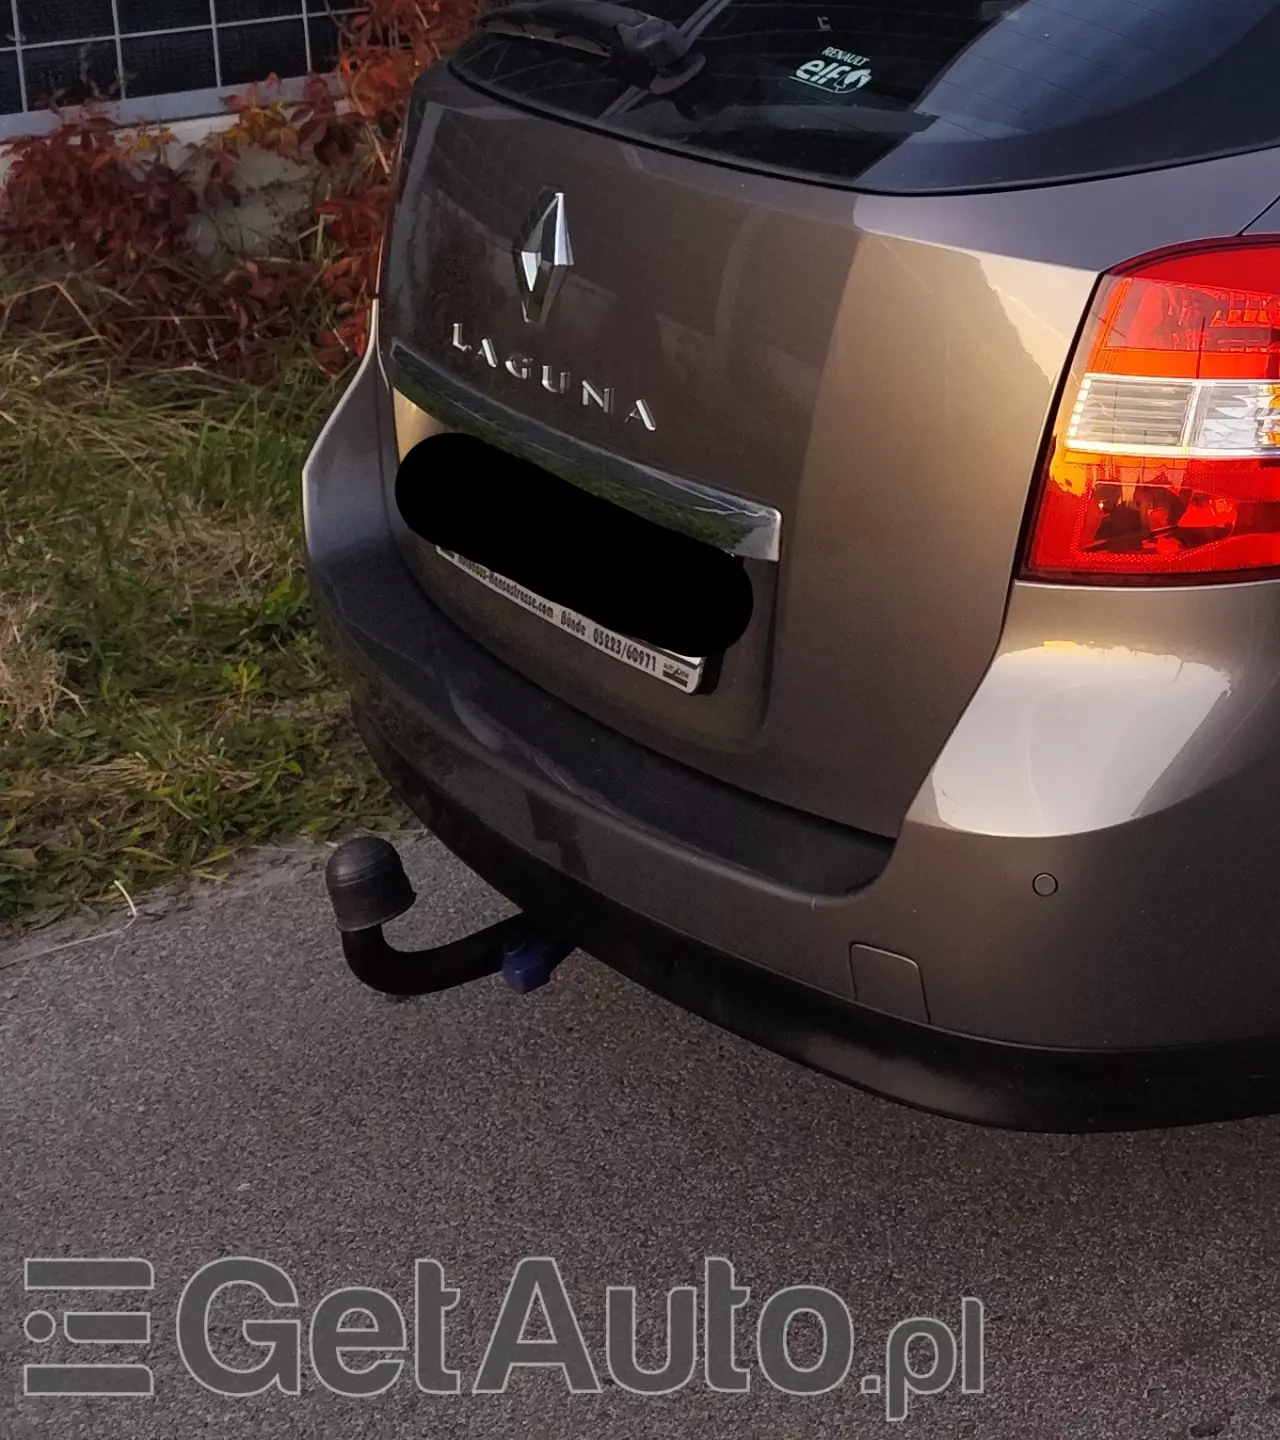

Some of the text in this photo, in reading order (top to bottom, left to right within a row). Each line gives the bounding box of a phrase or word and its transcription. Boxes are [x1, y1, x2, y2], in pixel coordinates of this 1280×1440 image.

[821, 46, 870, 68] RENAULT
[796, 59, 852, 85] elf
[452, 323, 657, 432] LAGUNA
